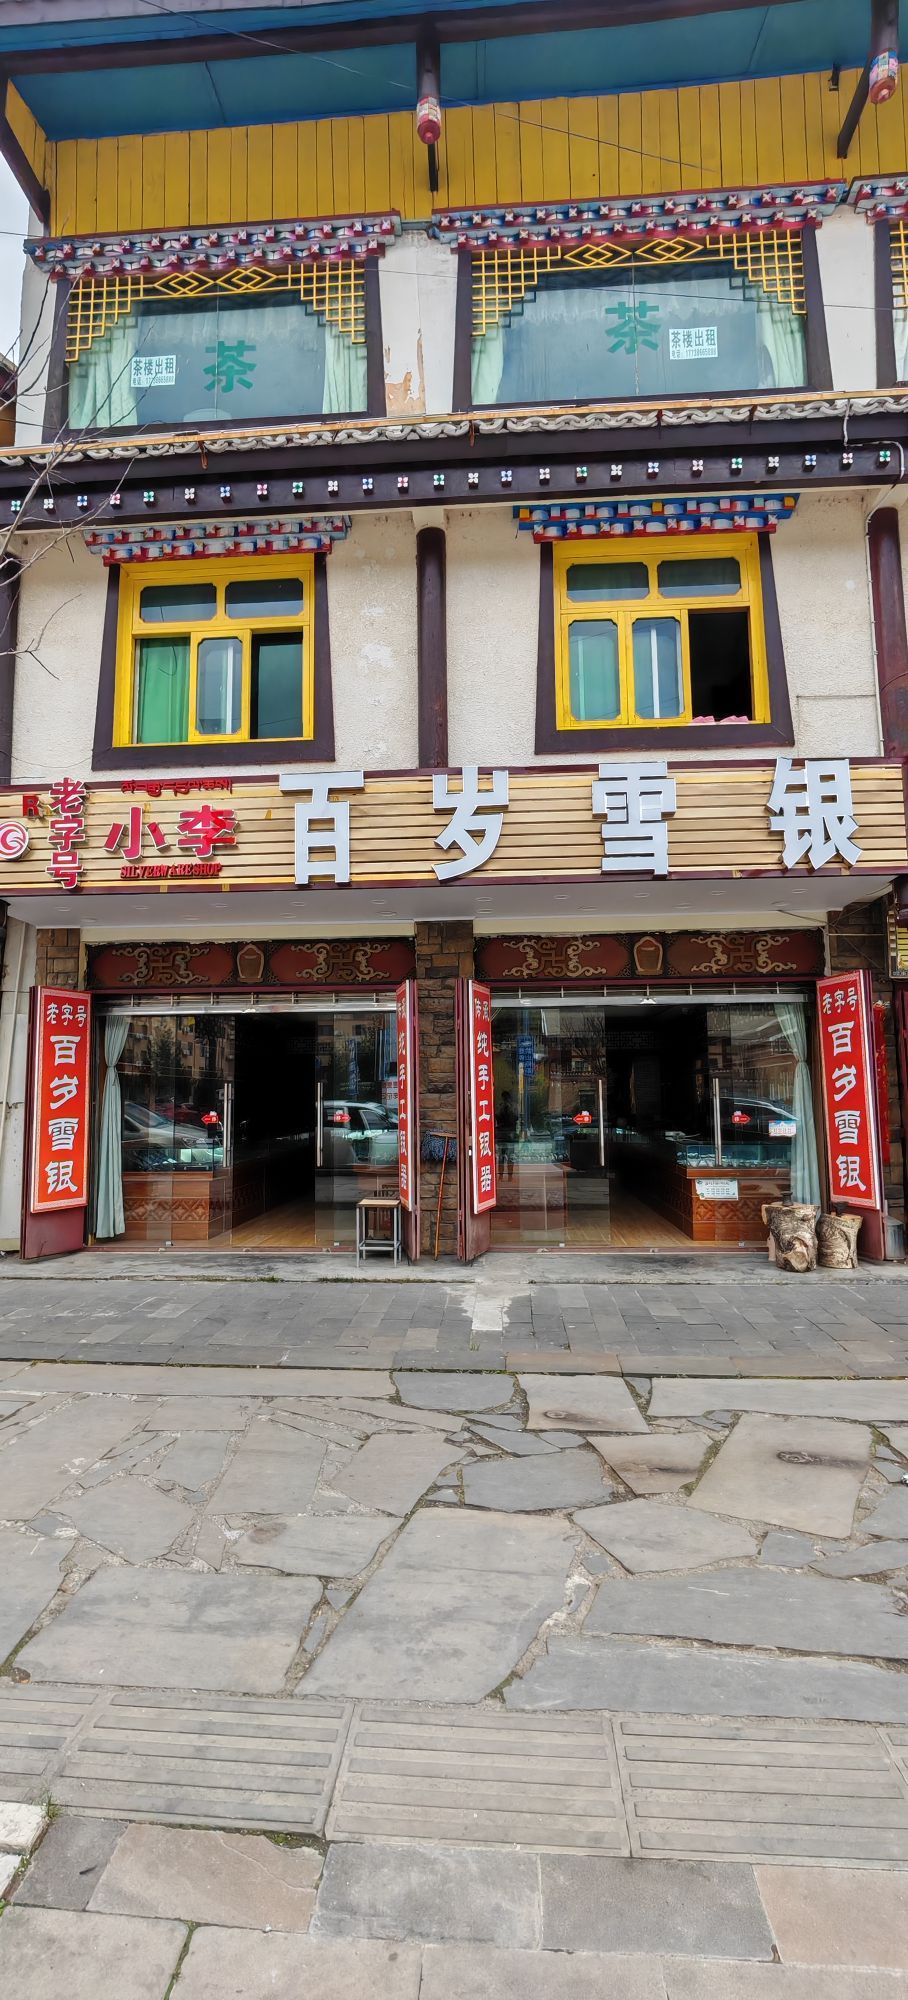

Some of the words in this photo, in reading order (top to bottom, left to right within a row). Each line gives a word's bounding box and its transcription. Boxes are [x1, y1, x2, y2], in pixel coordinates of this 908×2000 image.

[604, 301, 660, 354] 茶
[671, 329, 716, 349] 茶楼出租
[133, 357, 174, 376] 茶楼出租
[203, 340, 256, 393] 茶
[22, 794, 40, 817] R
[103, 804, 238, 860] 小李
[279, 757, 863, 885] 百岁雪银
[45, 776, 86, 889] 老字号
[120, 864, 193, 878] SILVERWARE
[193, 862, 223, 877] SHOP
[46, 1002, 87, 1027] 老字号
[822, 986, 858, 1014] 老字号
[44, 1035, 81, 1195] 百岁雪银
[477, 1031, 492, 1192] 纯手工银器
[827, 1020, 867, 1191] 百岁雪银
